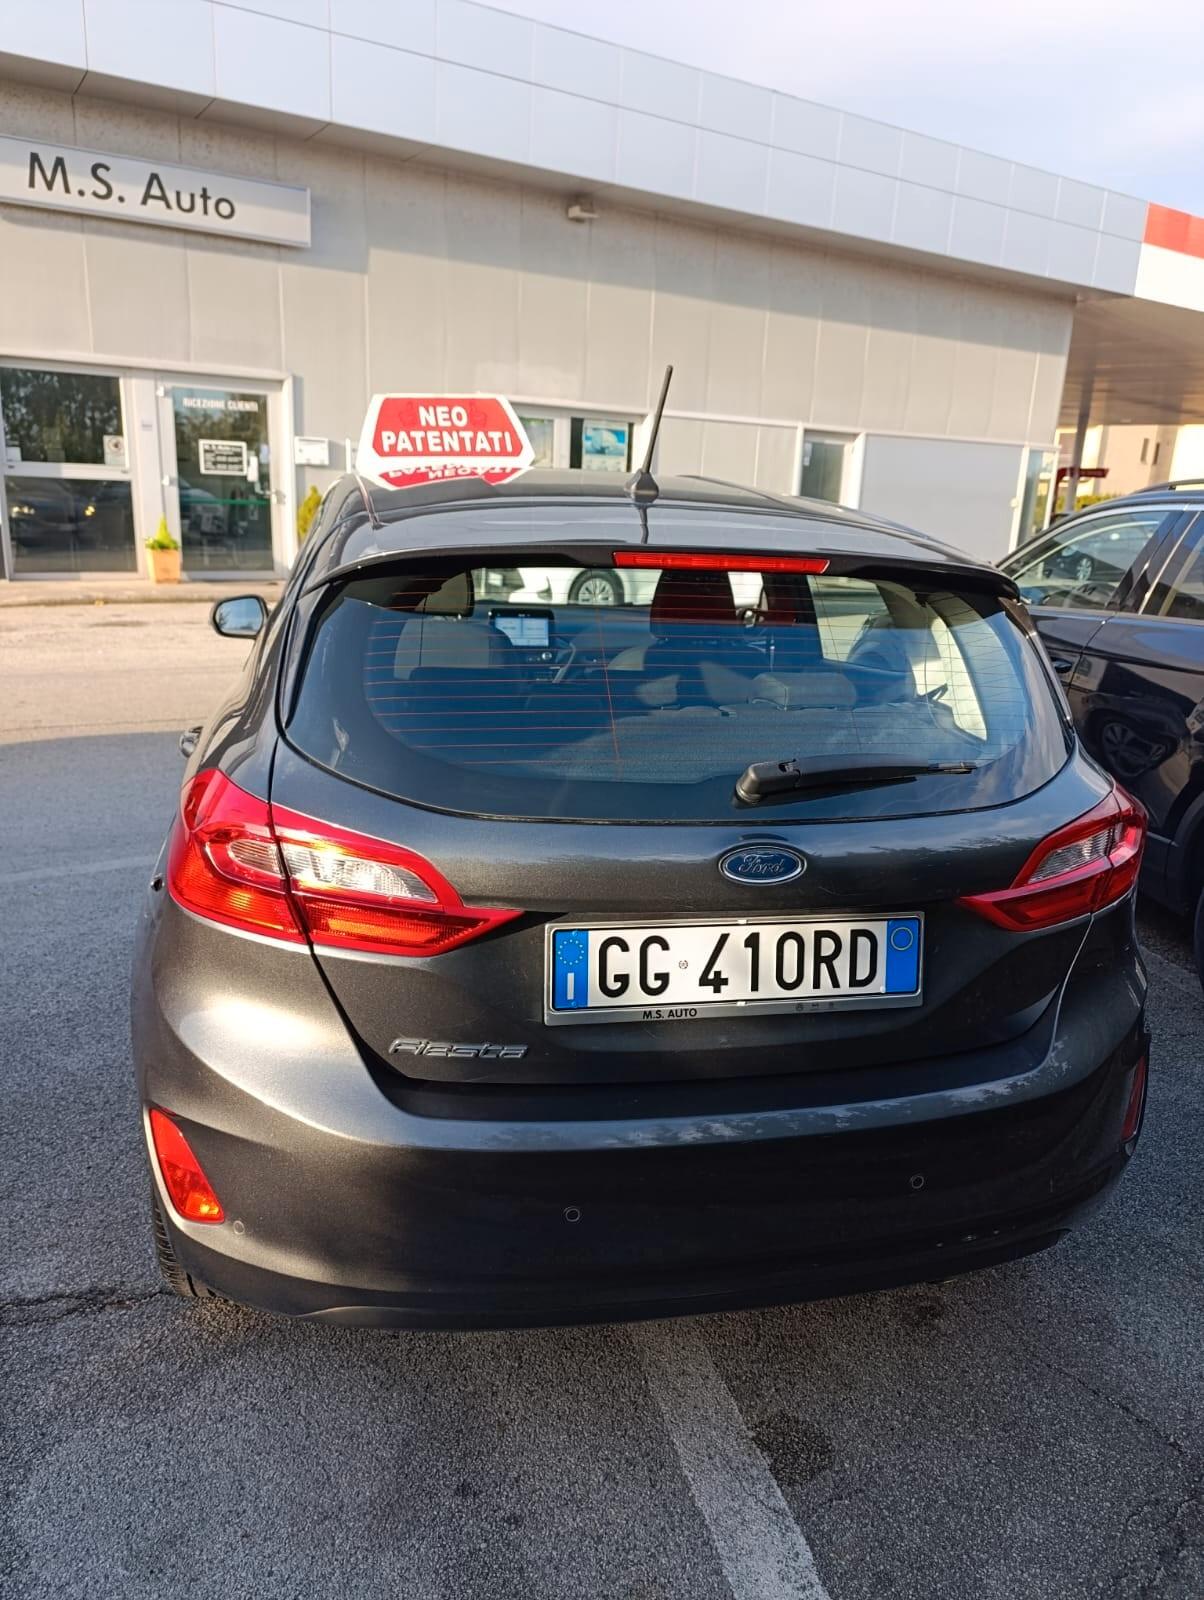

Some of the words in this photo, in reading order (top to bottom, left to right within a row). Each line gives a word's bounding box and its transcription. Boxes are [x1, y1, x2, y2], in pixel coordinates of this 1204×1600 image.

[28, 152, 126, 203] M.S.
[140, 172, 235, 220] Auto
[418, 405, 468, 427] NEO
[381, 430, 513, 453] PATENTATI
[738, 853, 785, 874] Ford
[598, 935, 671, 998] GG
[698, 928, 878, 994] 410RD
[642, 1009, 664, 1020] M.S.
[667, 1008, 698, 1019] AUTO
[388, 1038, 528, 1058] Fiesta
